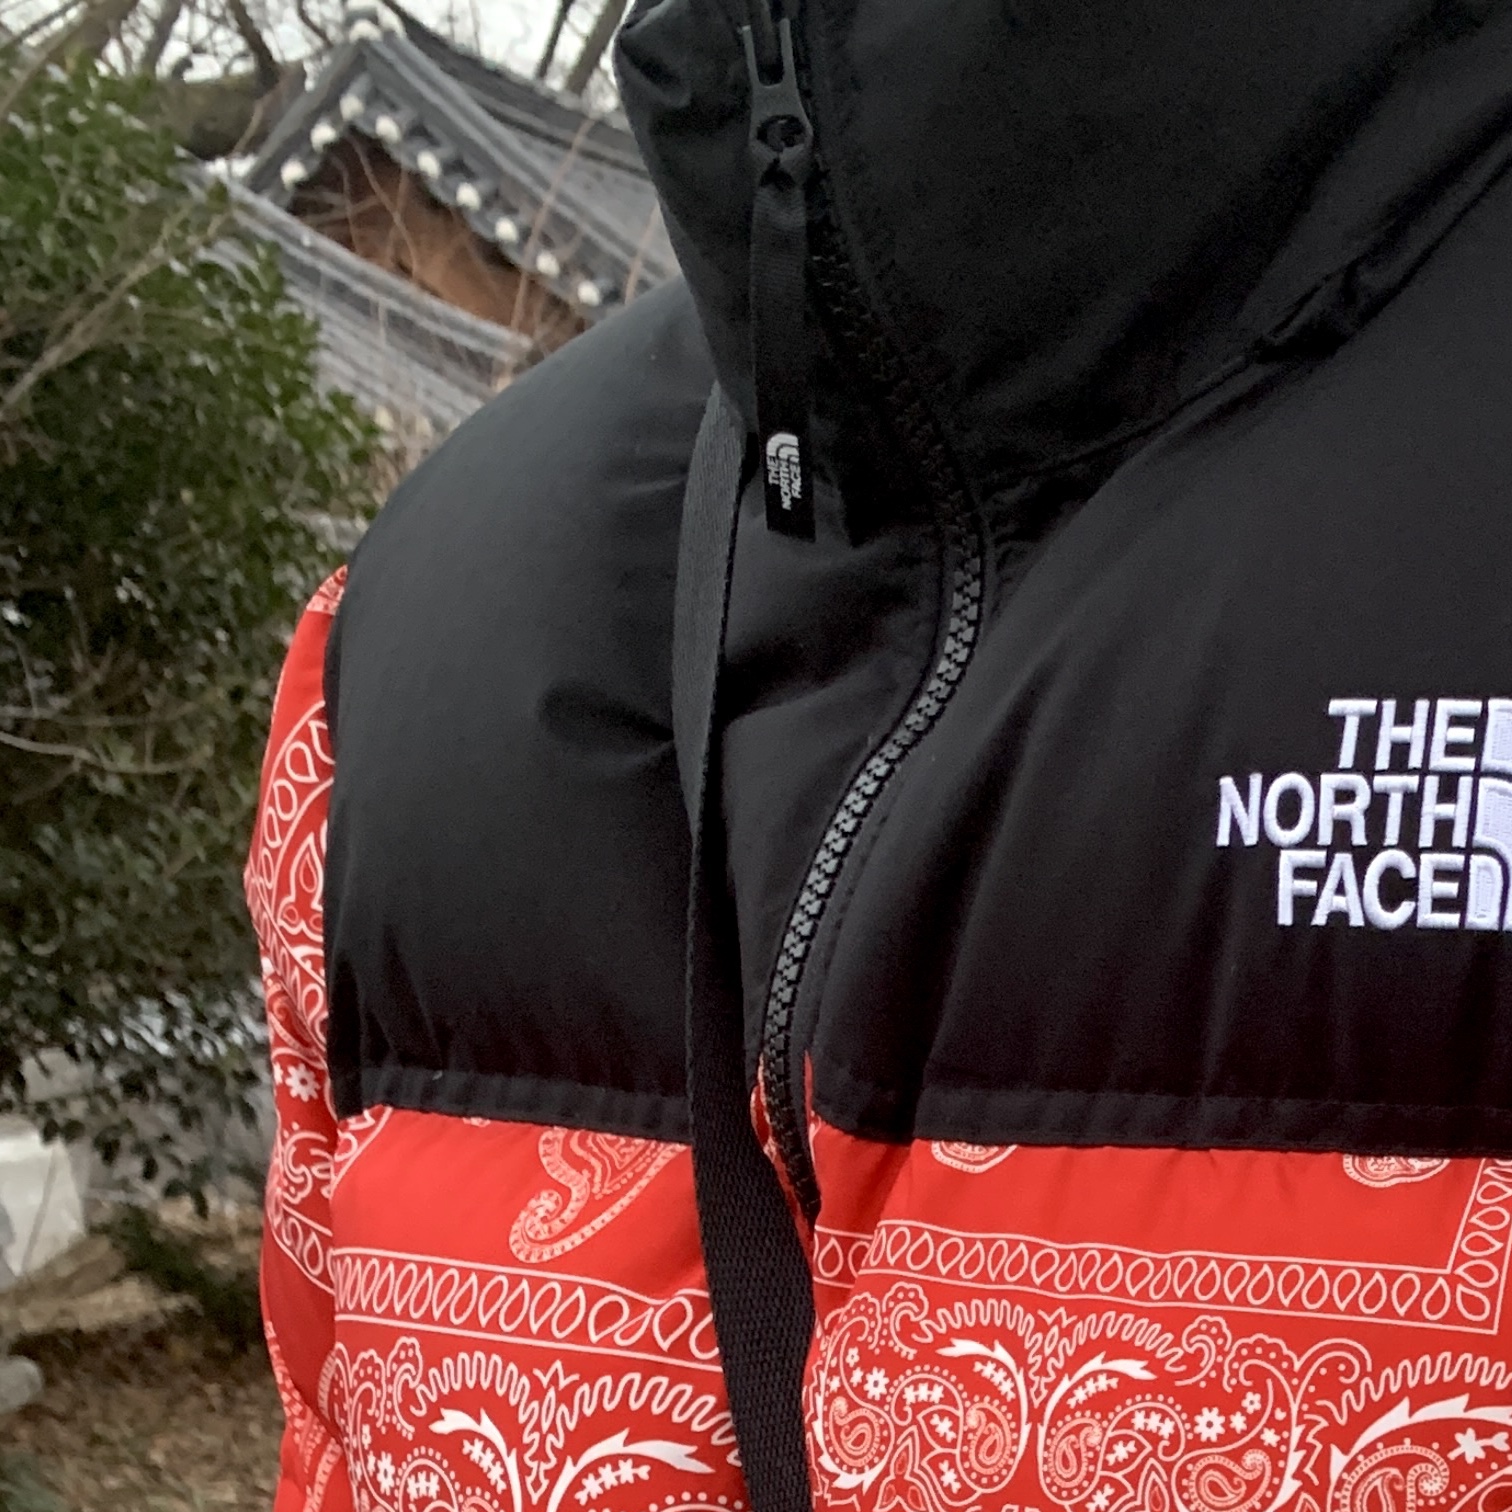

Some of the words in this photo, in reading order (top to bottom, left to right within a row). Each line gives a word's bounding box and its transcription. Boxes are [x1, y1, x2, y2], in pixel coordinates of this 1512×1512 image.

[767, 455, 779, 485] THE
[780, 459, 791, 510] NORTH
[790, 462, 802, 498] FACE
[1328, 698, 1483, 771] THE
[1216, 772, 1474, 848] NORTH
[1277, 849, 1467, 930] FACE
